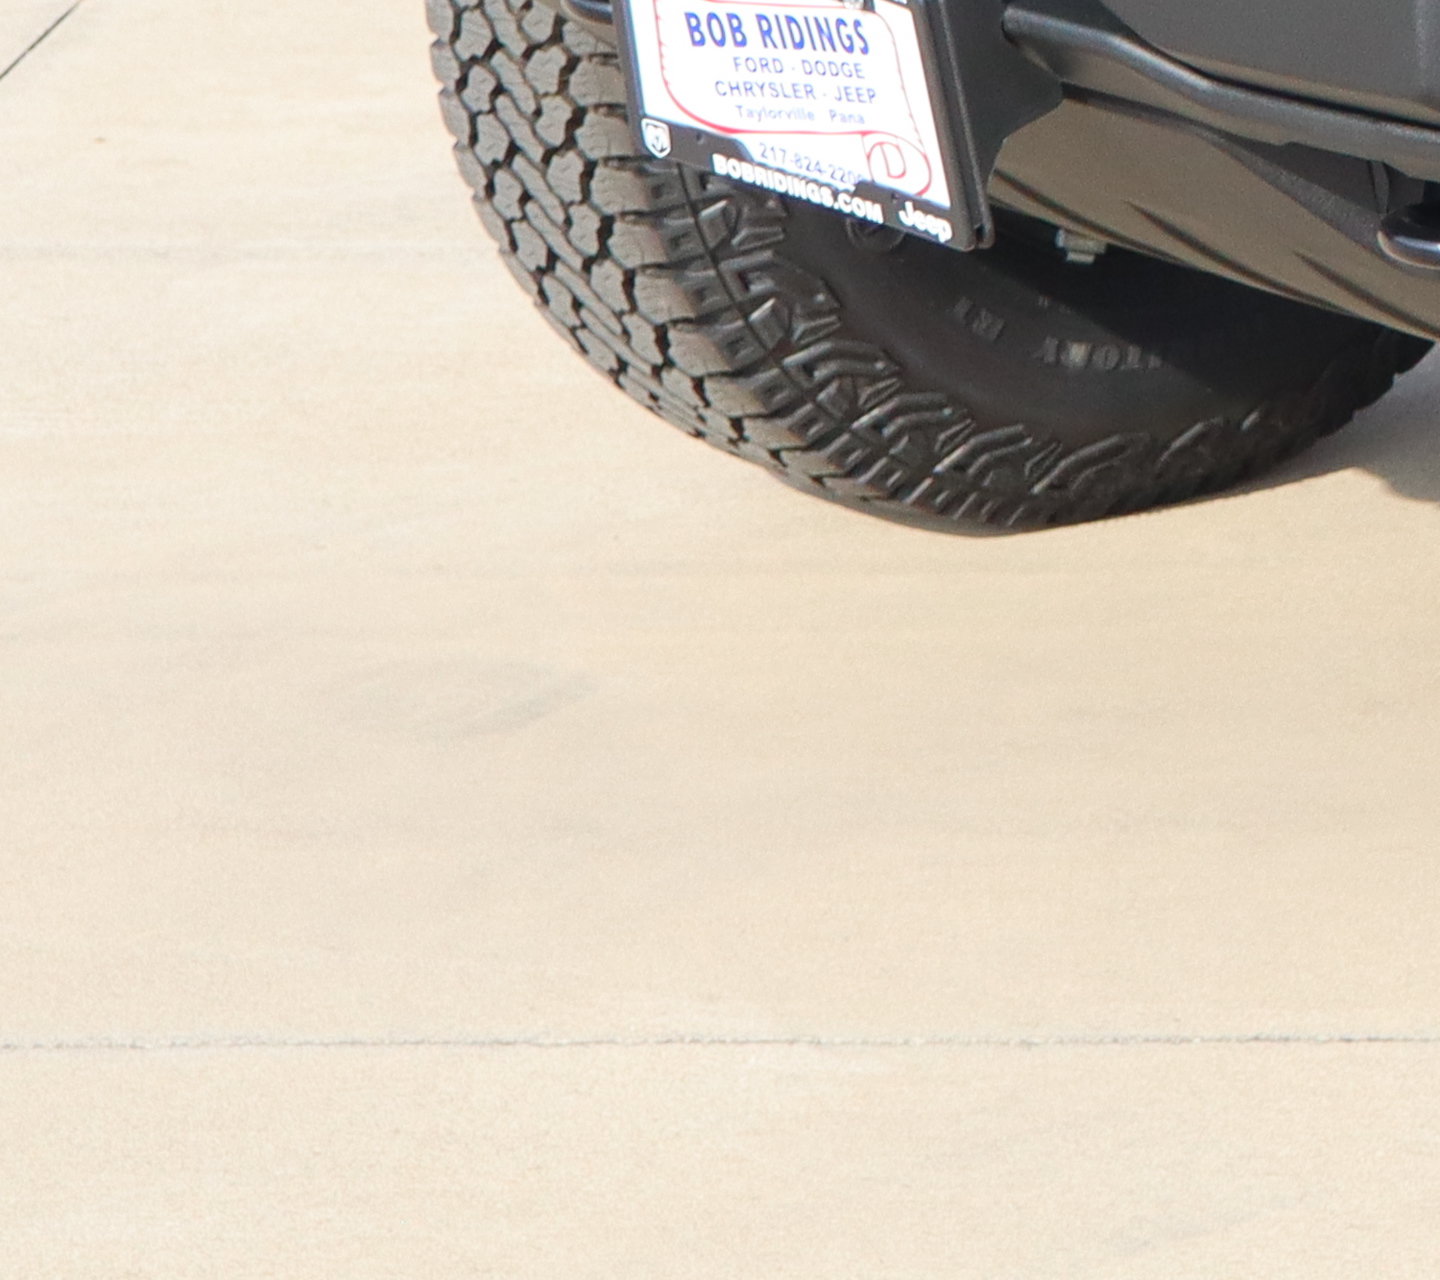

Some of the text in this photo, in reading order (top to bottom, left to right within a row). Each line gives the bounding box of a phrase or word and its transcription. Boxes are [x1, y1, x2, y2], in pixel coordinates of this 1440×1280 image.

[684, 11, 869, 55] BOB RIDINGS
[733, 56, 866, 79] FORD DODGE
[714, 81, 877, 104] CHRYSLER JEEP
[735, 104, 866, 125] Taylorville Pana
[712, 153, 884, 225] BOBRIDINGS.COM
[898, 200, 953, 243] Jeep
